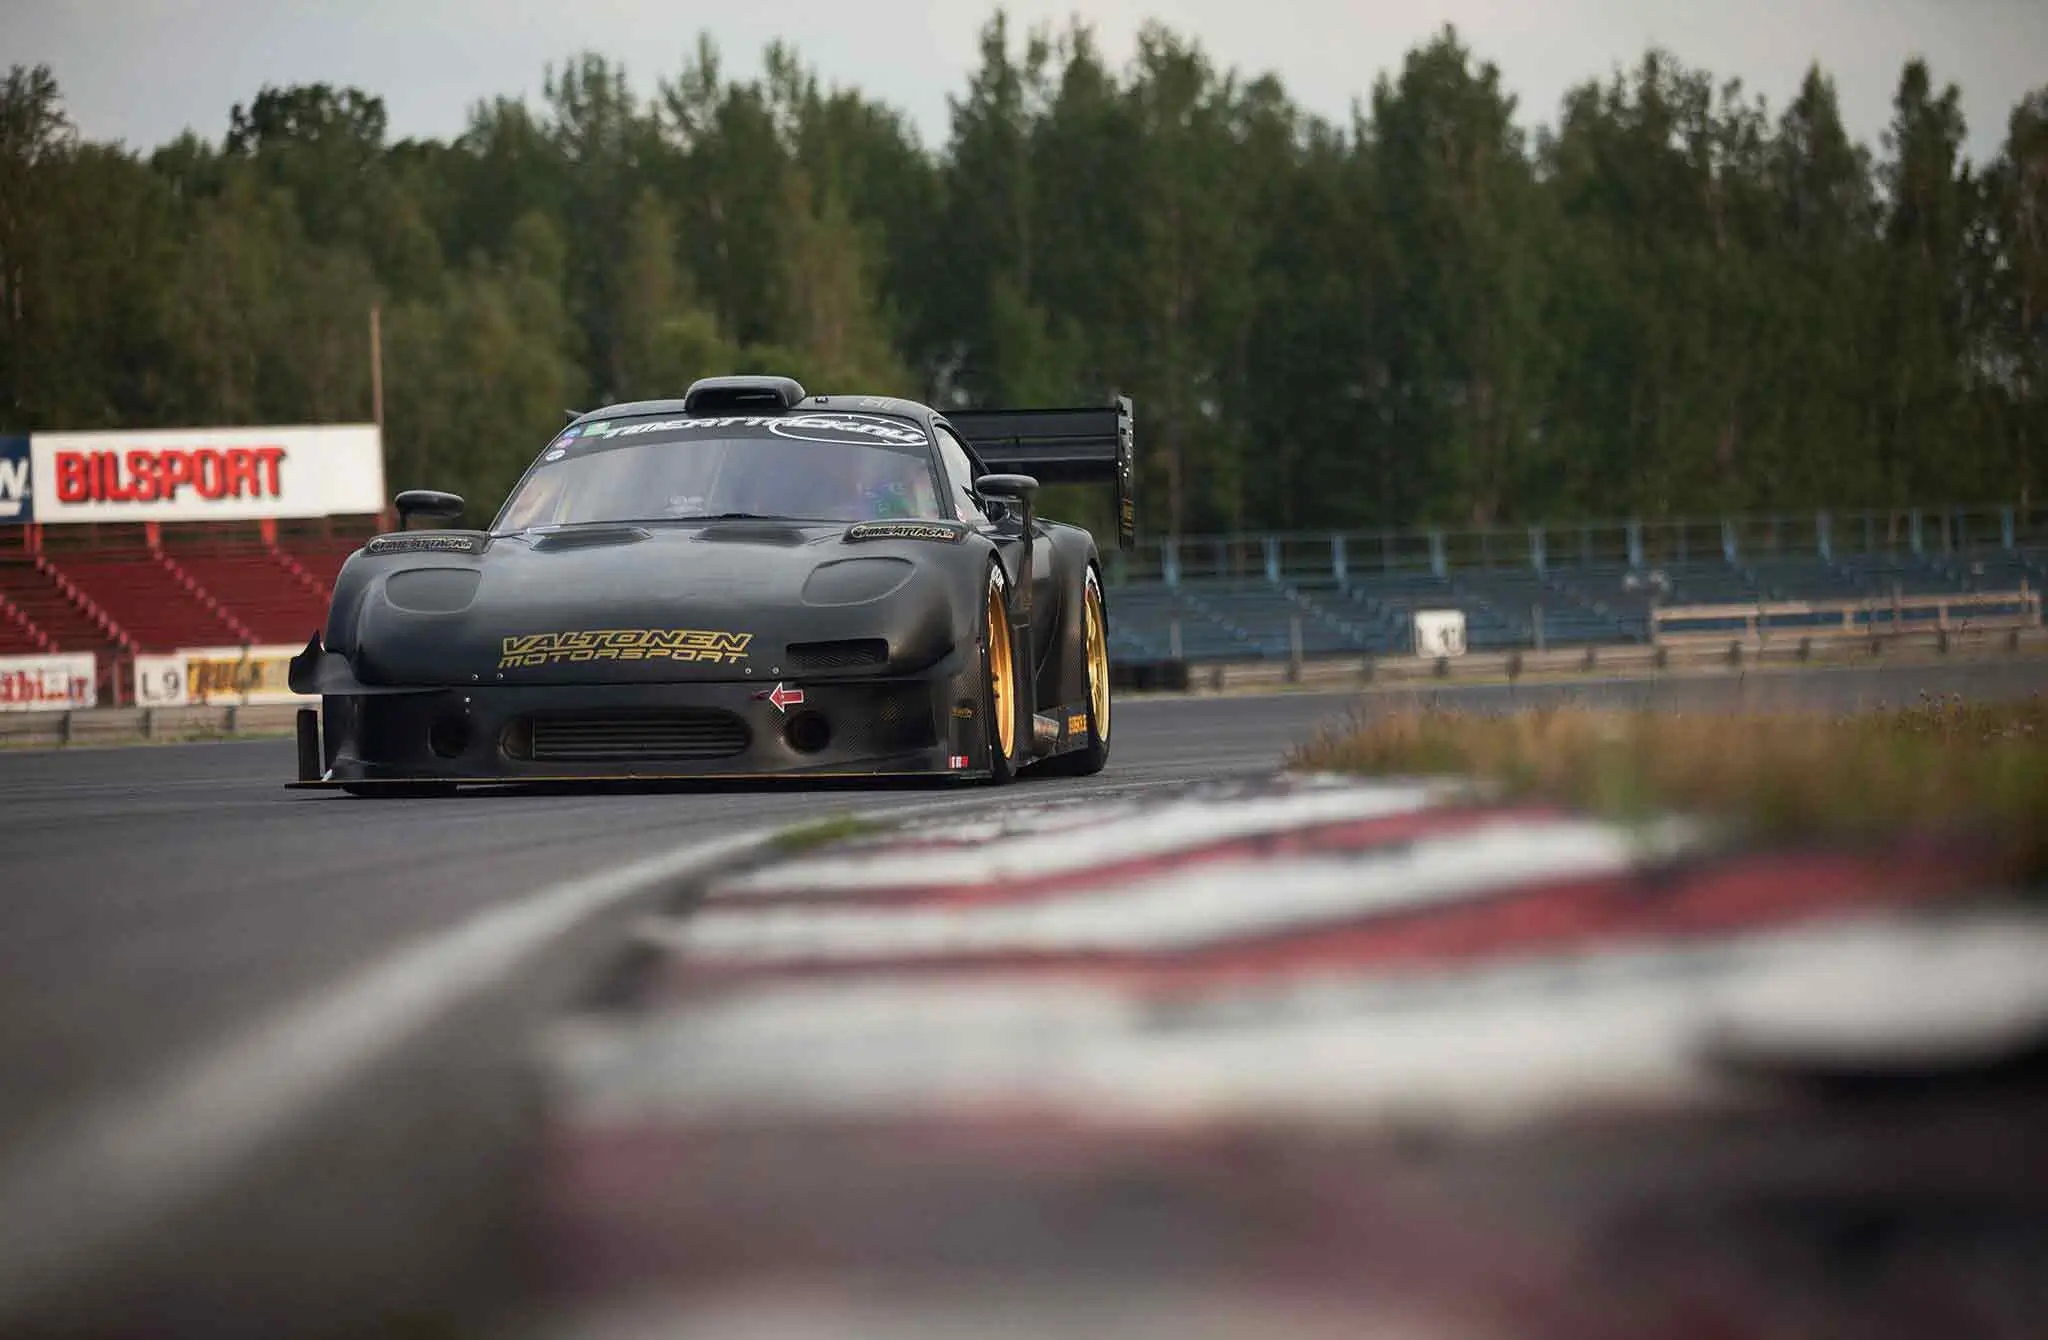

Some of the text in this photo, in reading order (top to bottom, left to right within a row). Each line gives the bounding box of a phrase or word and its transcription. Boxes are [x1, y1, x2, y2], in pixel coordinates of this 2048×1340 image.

[55, 447, 286, 504] BILSPORT
[503, 629, 753, 656] VALTONEN
[498, 647, 749, 669] MOTORSPORT
